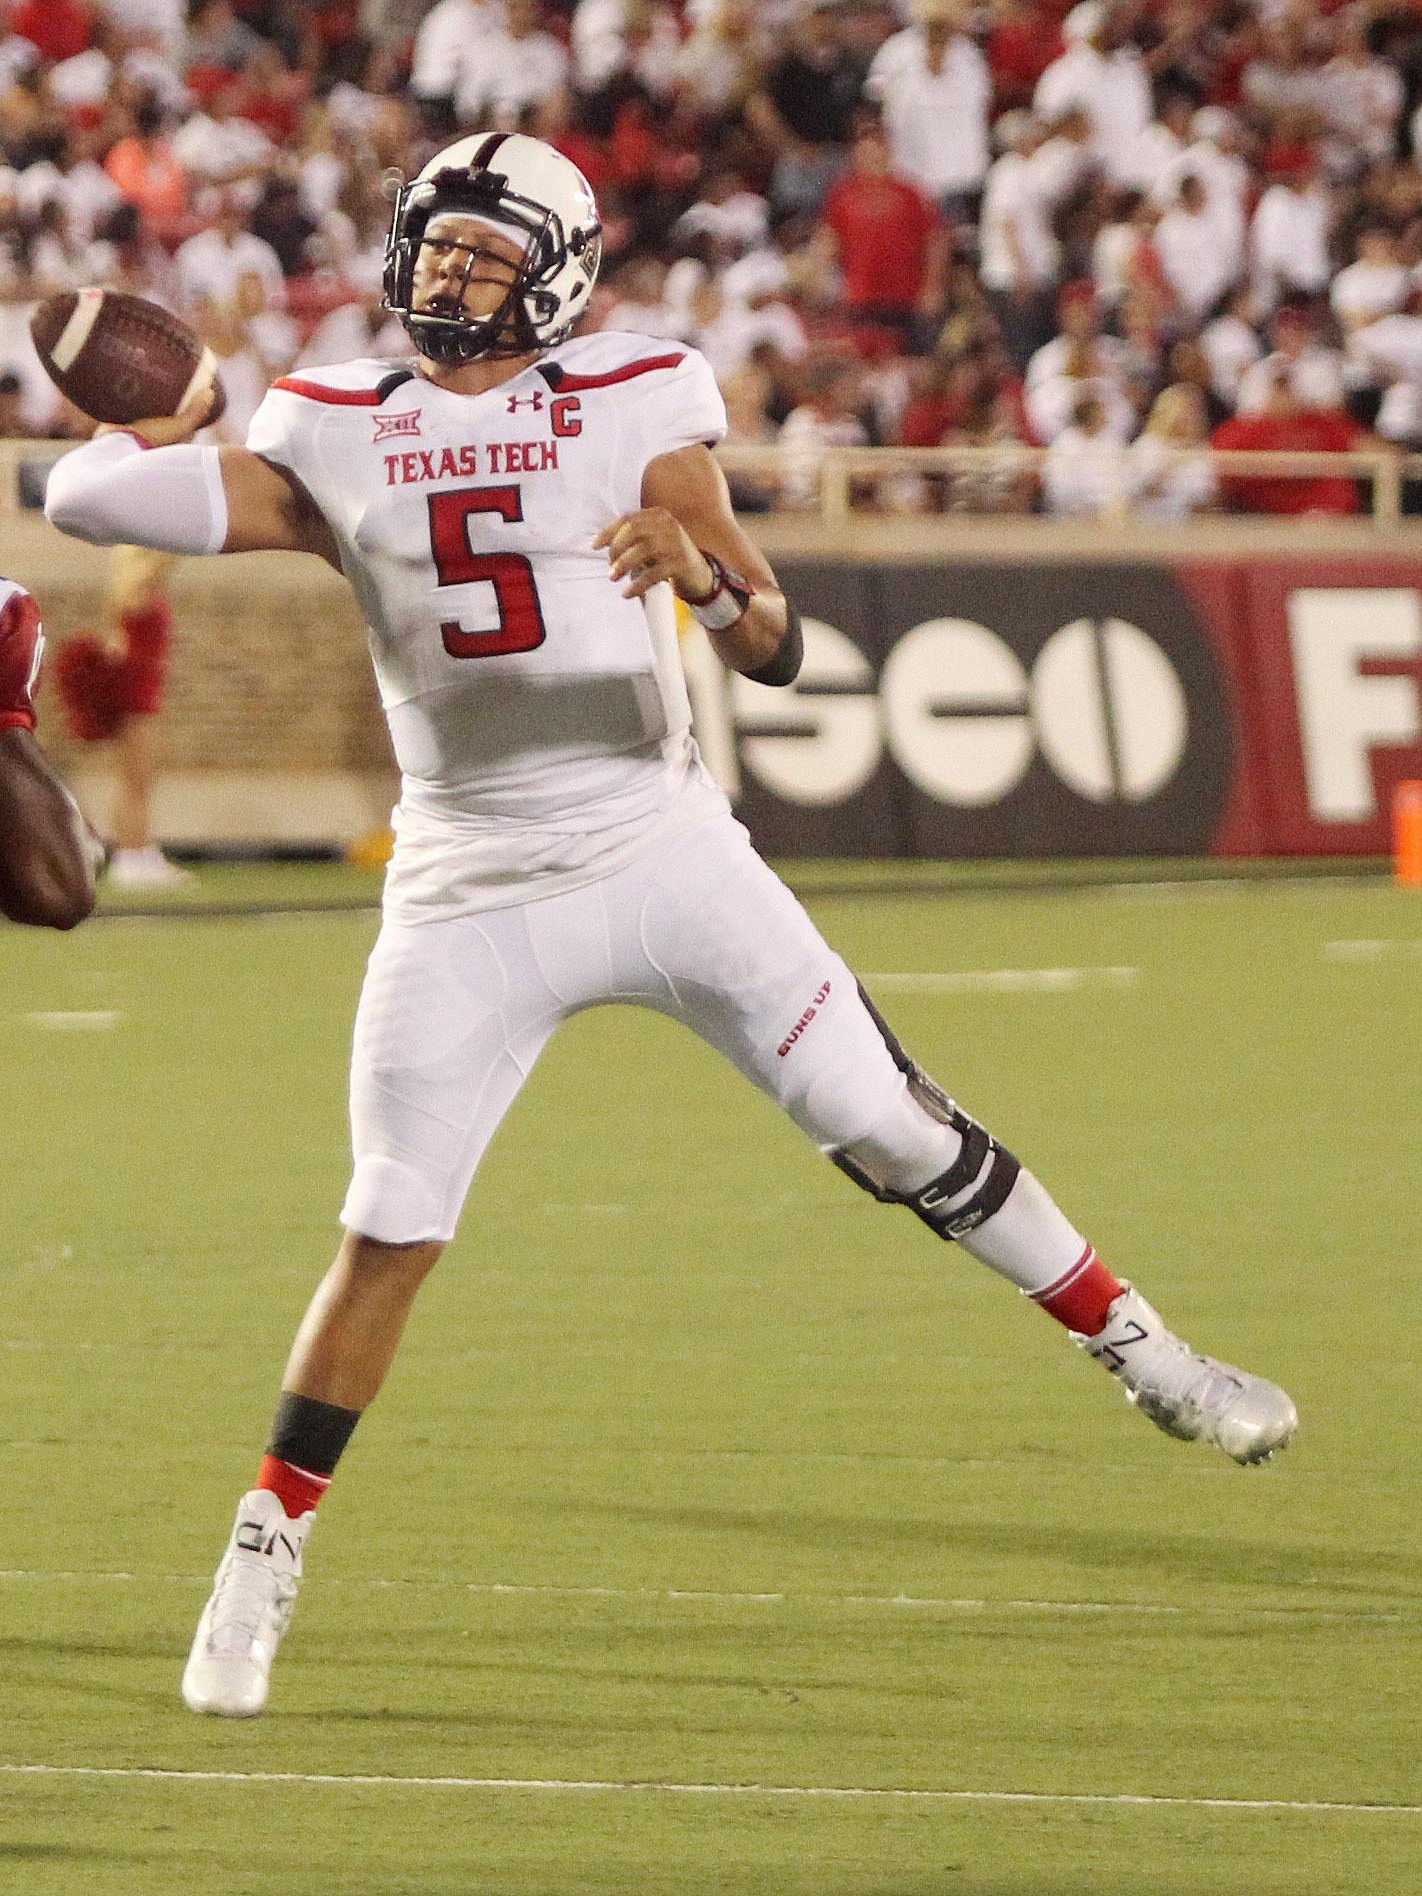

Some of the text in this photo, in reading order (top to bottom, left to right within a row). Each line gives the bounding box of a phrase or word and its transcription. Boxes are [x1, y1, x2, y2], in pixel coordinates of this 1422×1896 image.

[550, 395, 583, 438] C
[384, 439, 559, 486] TEXAS TECH
[427, 483, 547, 659] 5
[777, 980, 832, 1058] GUNS UP
